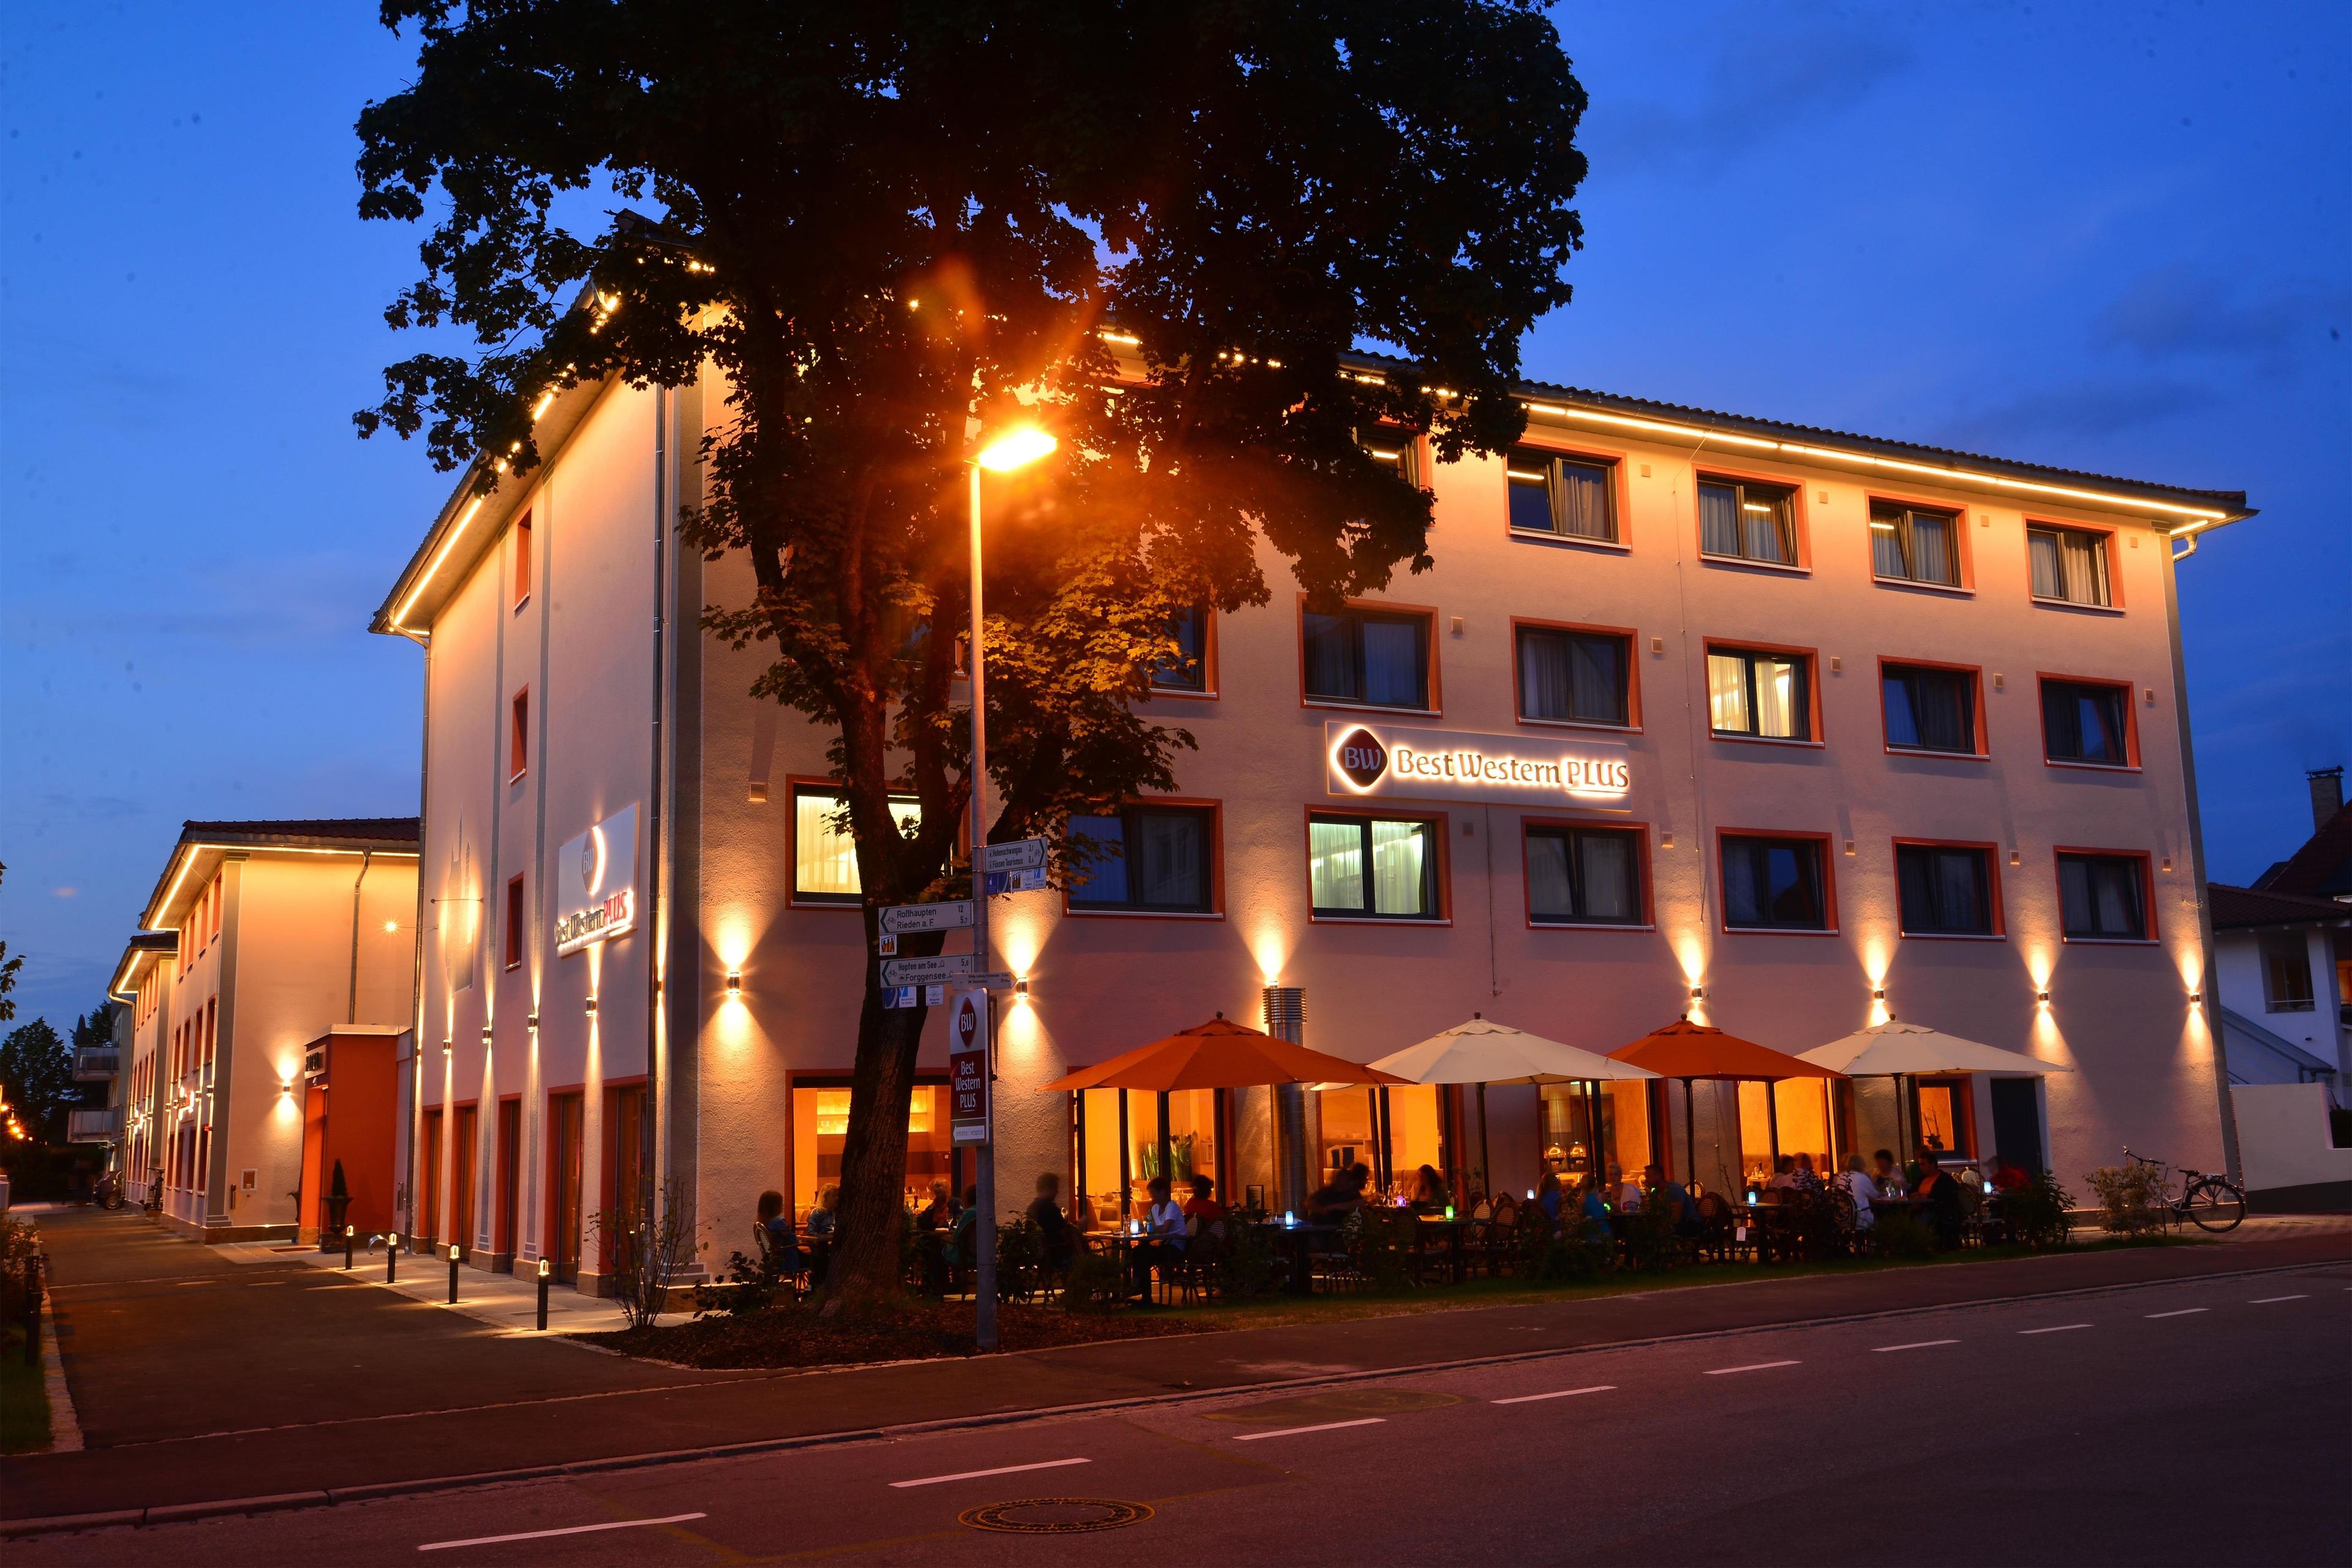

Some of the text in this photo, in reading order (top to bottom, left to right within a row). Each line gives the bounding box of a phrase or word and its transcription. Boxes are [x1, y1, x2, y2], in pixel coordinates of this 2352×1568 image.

[1344, 747, 1381, 771] BW
[1397, 749, 1629, 788] Best Western PLUS
[583, 848, 594, 874] BW
[897, 905, 964, 918] Roßhaupten 12
[897, 920, 921, 929] Rieden
[929, 918, 934, 927] F.
[898, 962, 917, 972] Hopfen
[905, 972, 946, 982] Forggensee
[961, 1012, 974, 1032] BW
[961, 1060, 974, 1075] Best
[956, 1077, 980, 1091] Western
[960, 1093, 976, 1109] PLUS
